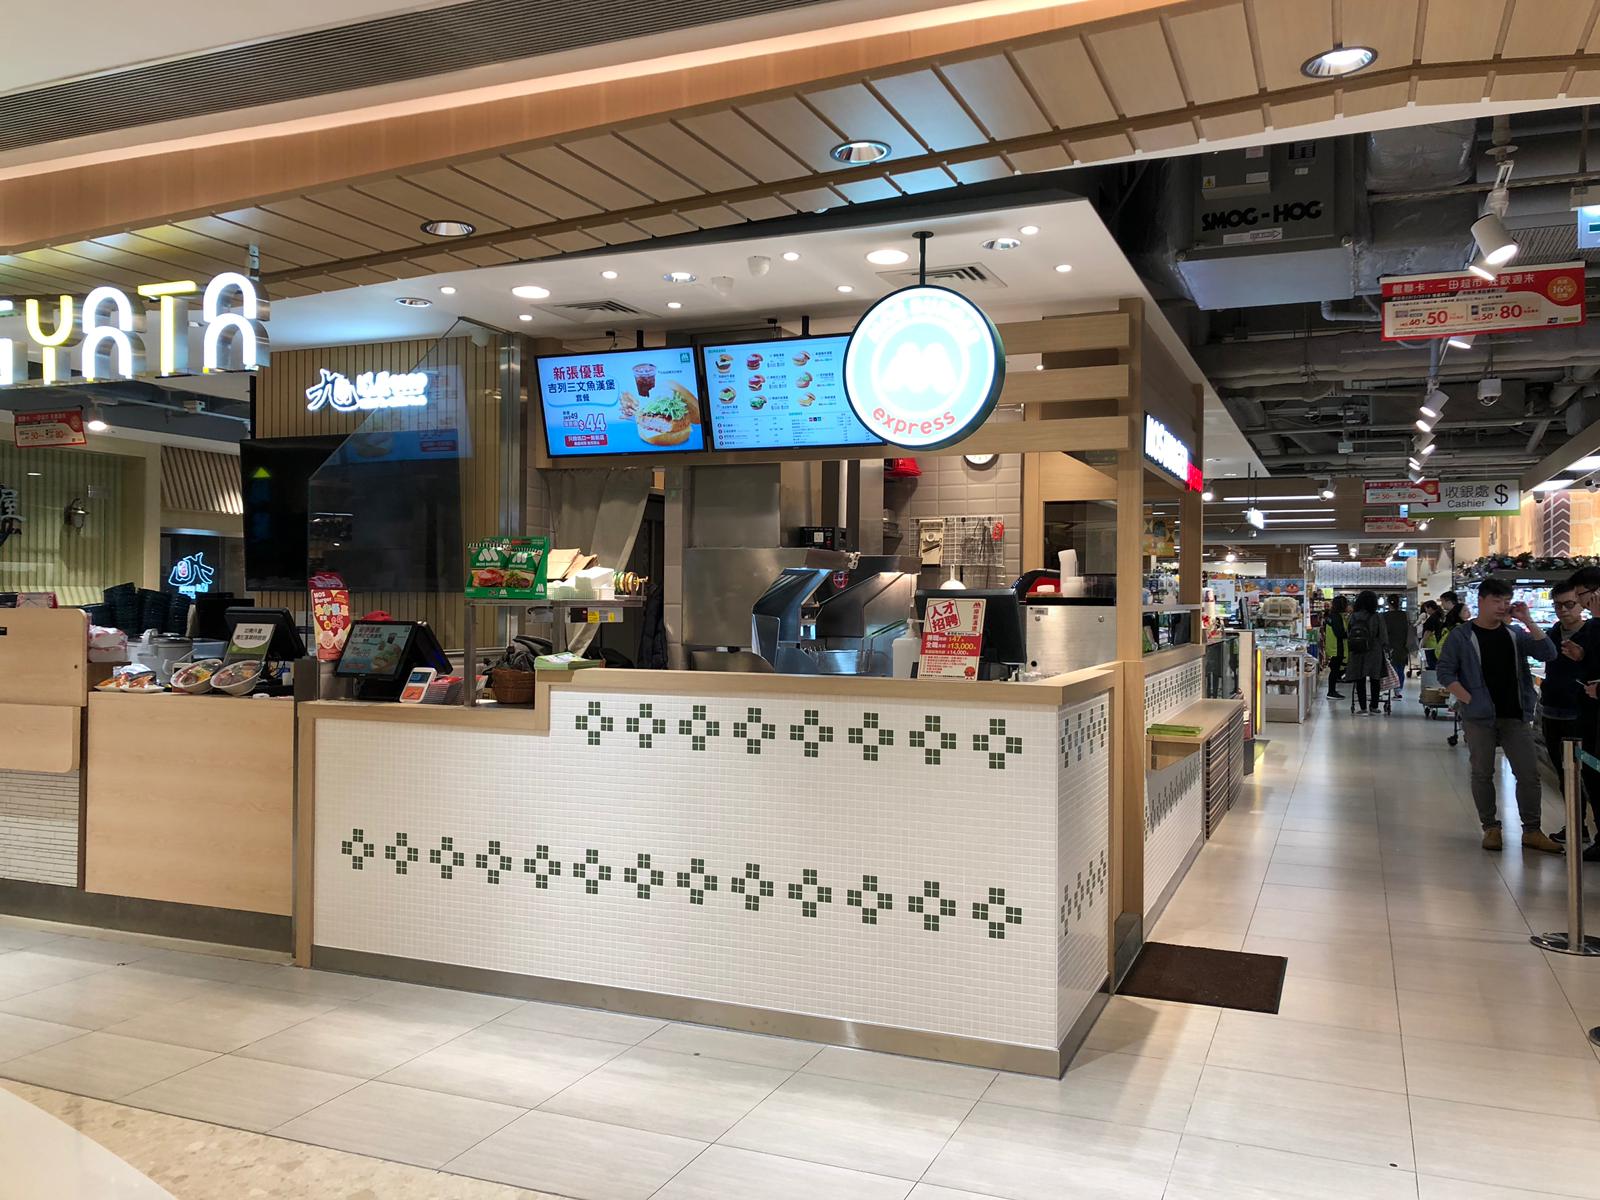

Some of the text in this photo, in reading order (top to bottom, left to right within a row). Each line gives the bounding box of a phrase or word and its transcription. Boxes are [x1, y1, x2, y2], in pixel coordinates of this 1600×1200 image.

[1500, 304, 1523, 319] 80
[26, 271, 259, 386] YATA
[553, 363, 606, 381] 新張優惠
[547, 379, 616, 394] 吉列三文魚漢堡
[578, 413, 607, 433] $44
[872, 407, 956, 435] express
[1445, 485, 1490, 499] 收銀處
[1447, 499, 1486, 508] Cashier
[930, 601, 955, 620] 人才
[931, 613, 959, 632] 招聘
